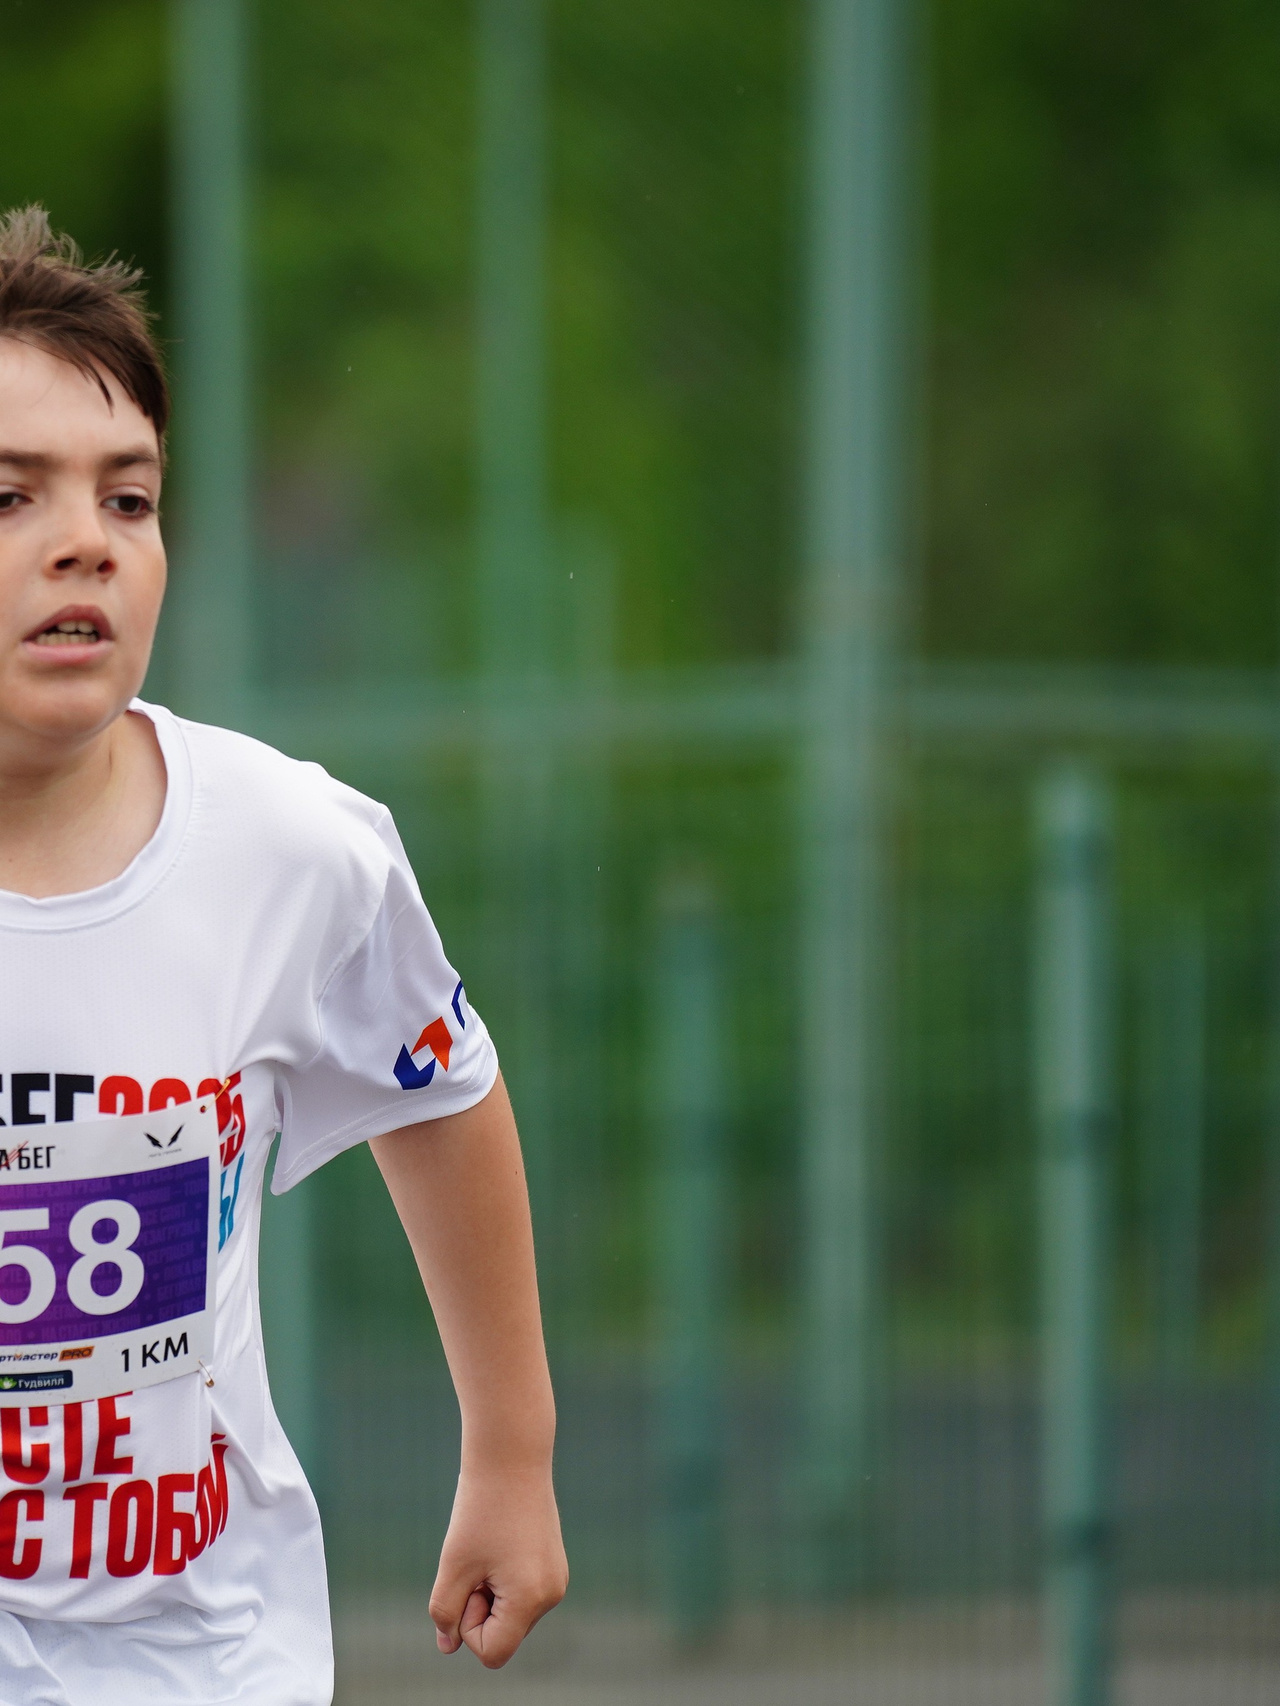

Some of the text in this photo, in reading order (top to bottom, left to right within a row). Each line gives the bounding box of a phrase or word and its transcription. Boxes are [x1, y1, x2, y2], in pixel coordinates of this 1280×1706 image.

[61, 1348, 93, 1361] PRO
[121, 1348, 130, 1373] 1
[18, 1377, 65, 1389] Гудвилл
[62, 1433, 229, 1580] ТОБОЙ
